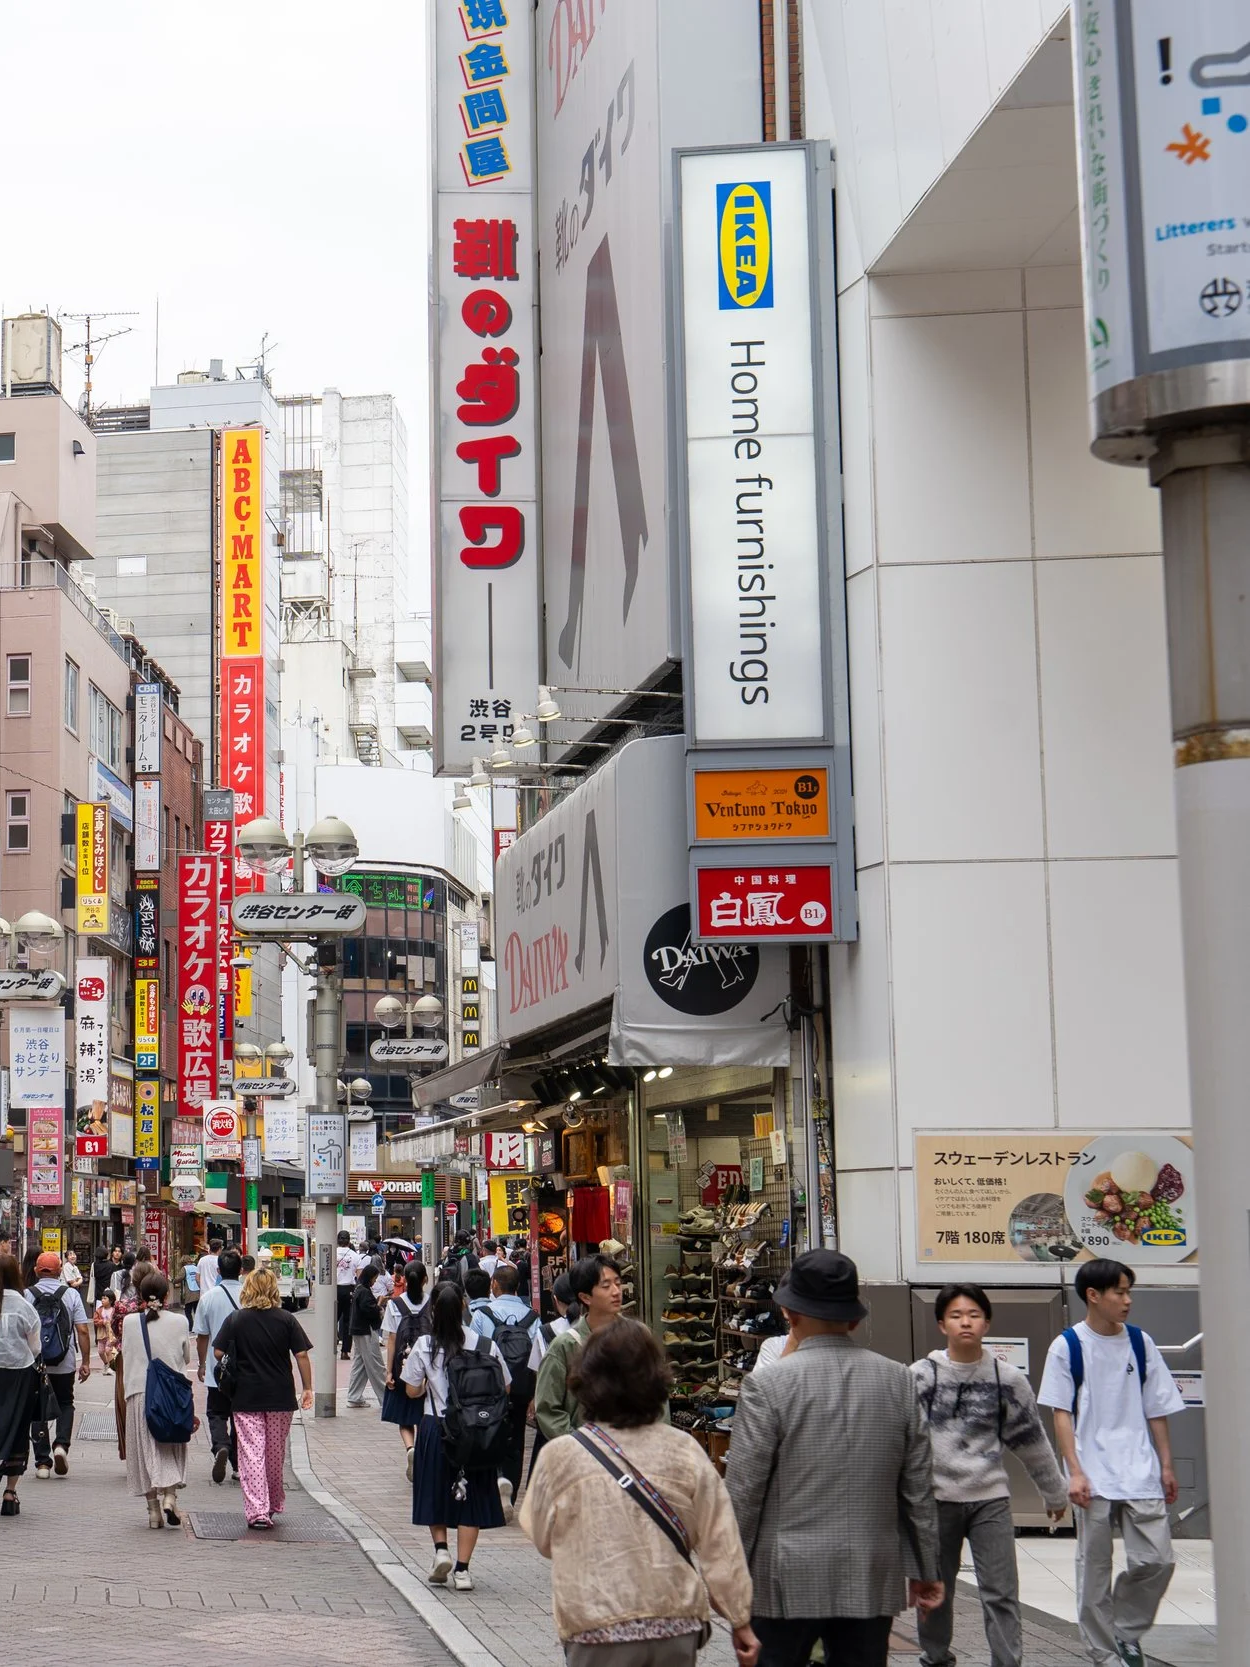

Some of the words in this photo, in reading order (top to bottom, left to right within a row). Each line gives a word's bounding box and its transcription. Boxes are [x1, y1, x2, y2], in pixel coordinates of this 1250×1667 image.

[463, 0, 512, 179] 現金問屋
[1155, 217, 1236, 242] Litterers
[734, 194, 757, 299] IKEA
[453, 217, 525, 570] 靴のダイワ
[730, 340, 766, 461] Home
[231, 438, 254, 648] ABC-MART
[729, 473, 777, 706] furnishings
[137, 683, 158, 694] CBR
[469, 698, 512, 719] 渋谷
[138, 695, 149, 762] モニタールーム
[232, 673, 253, 784] カラオケ
[141, 764, 154, 772] 5F
[704, 802, 766, 818] Ventuno
[771, 800, 818, 820] Tokyo
[93, 807, 106, 891] 全身もみほぐし
[145, 855, 157, 864] 4F
[515, 832, 566, 917] 靴のダイワ
[734, 874, 797, 886] 中国料理
[184, 857, 213, 982] カラオケ
[238, 903, 359, 920] 渋谷センター街
[709, 891, 796, 928] 白鳳
[138, 959, 156, 967] 3F
[504, 923, 569, 1015] DAIWA
[25, 1038, 50, 1051] 渋谷
[79, 1014, 96, 1084] 麻辣湯
[374, 1044, 443, 1057] 渋谷センター街
[14, 1053, 60, 1064] おとなり
[140, 1054, 155, 1066] 2F
[182, 1018, 213, 1110] 歌広場
[14, 1065, 61, 1078] サンデー
[235, 1081, 291, 1090] 渋谷センター街
[140, 1103, 155, 1133] 松屋
[212, 1119, 234, 1130] 消火栓
[84, 1140, 99, 1153] B1
[933, 1150, 1097, 1167] スウェーデンレストラン
[935, 1231, 960, 1245] 7階
[963, 1230, 1006, 1245] 180席
[1145, 1233, 1183, 1241] IKEA
